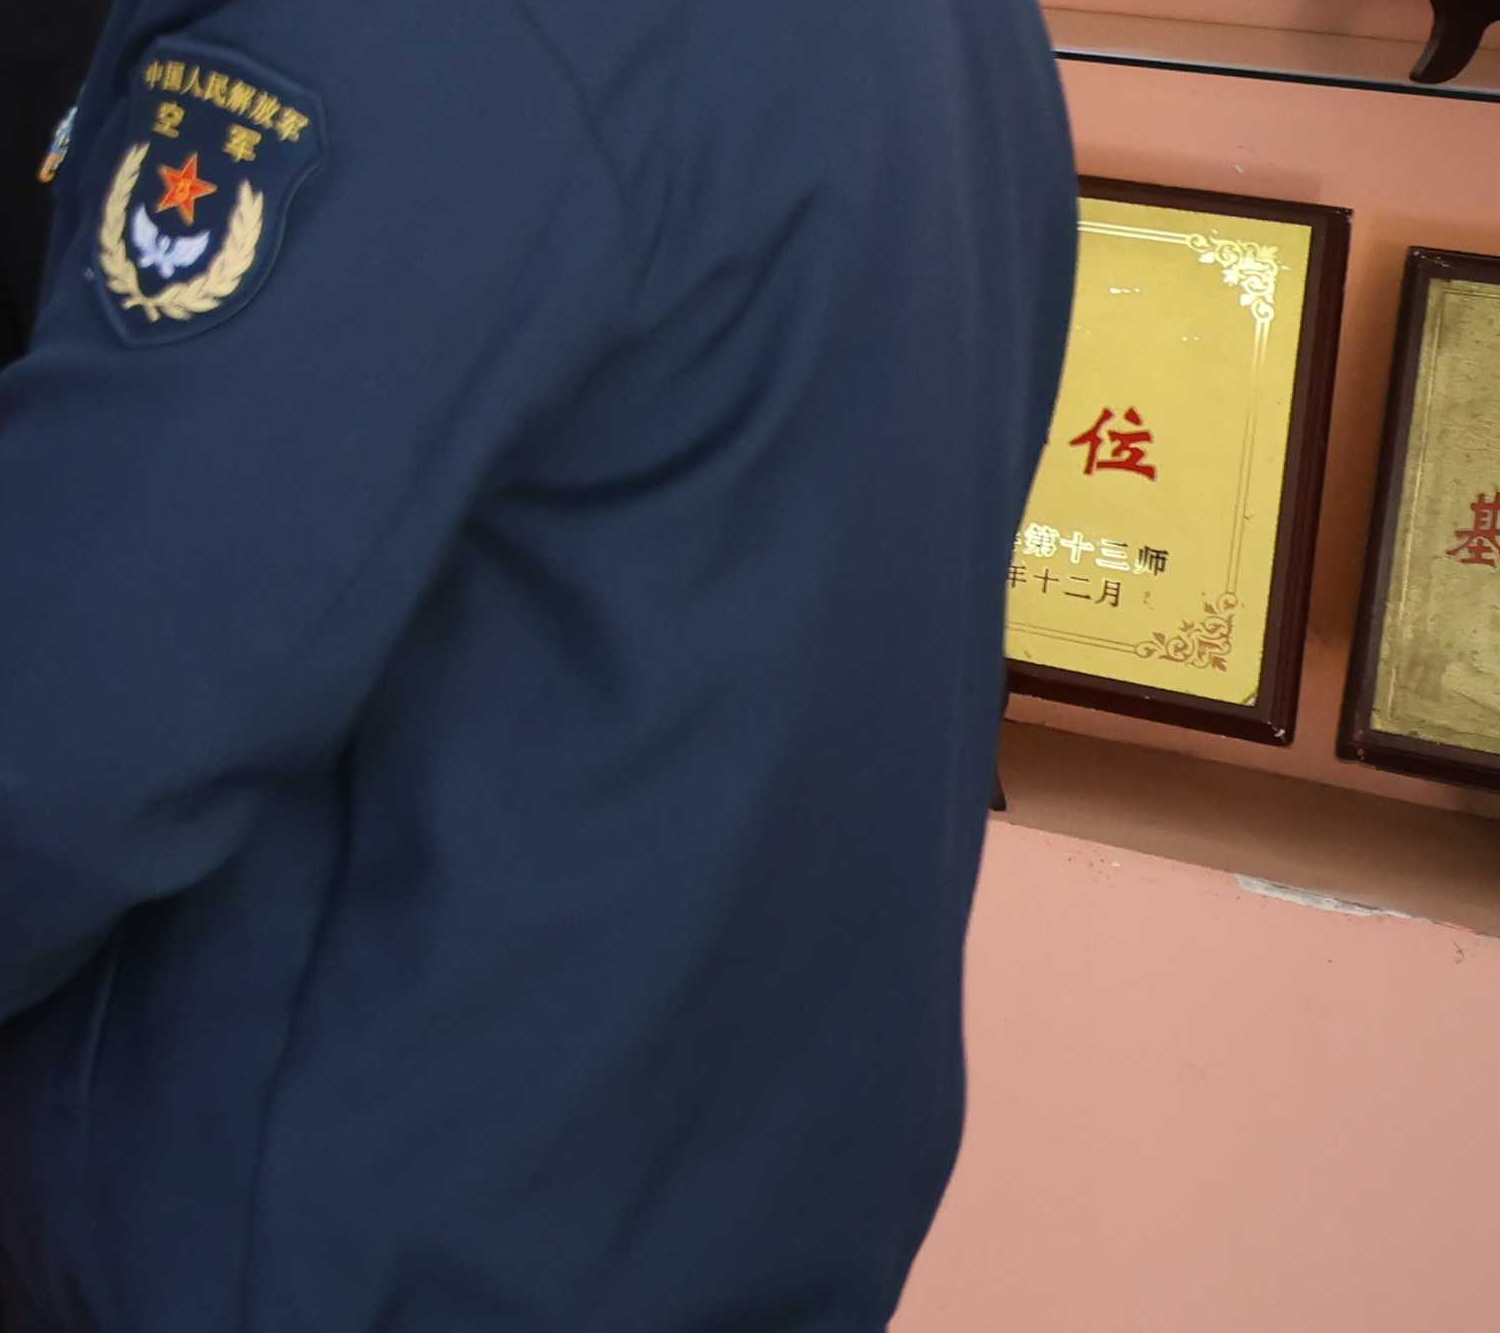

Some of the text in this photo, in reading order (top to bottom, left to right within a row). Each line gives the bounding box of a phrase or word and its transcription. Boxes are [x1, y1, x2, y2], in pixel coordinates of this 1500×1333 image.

[143, 60, 312, 143] 中国人民解放军
[1069, 407, 1158, 481] 位
[1014, 523, 1170, 577] 第十三师
